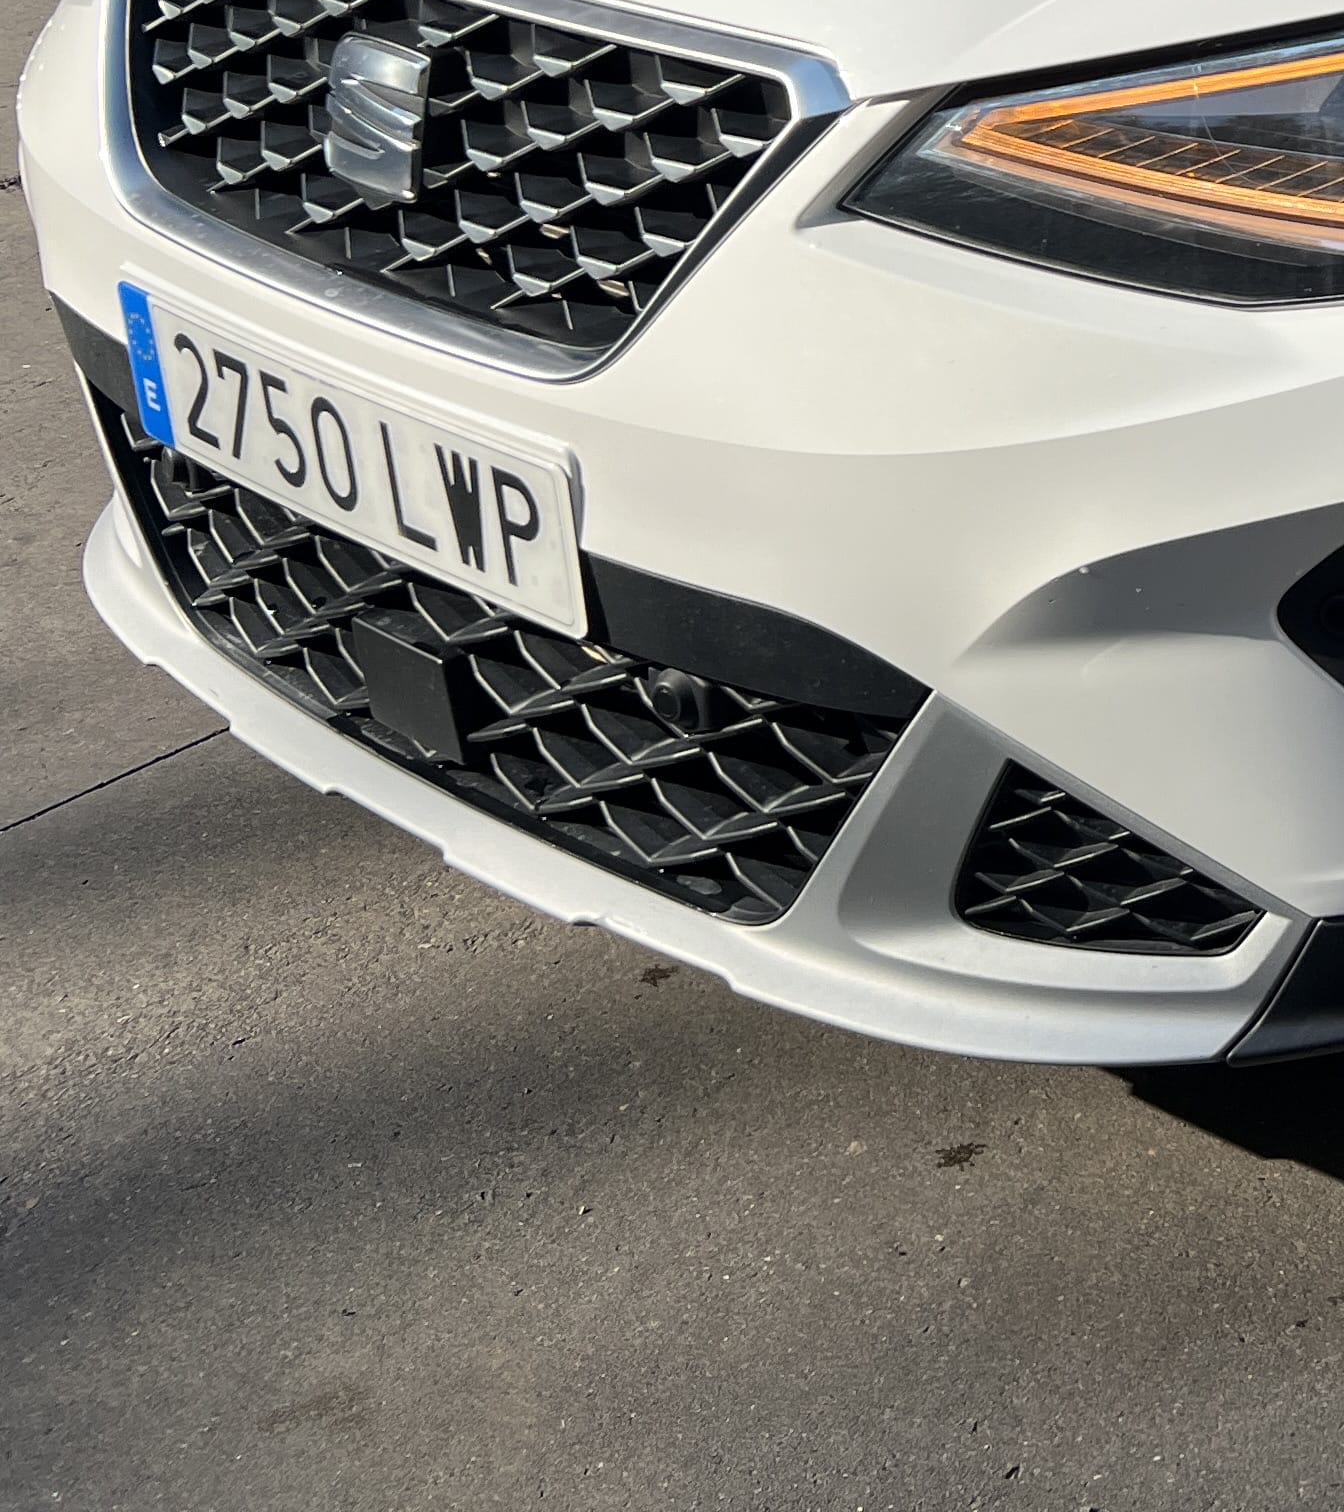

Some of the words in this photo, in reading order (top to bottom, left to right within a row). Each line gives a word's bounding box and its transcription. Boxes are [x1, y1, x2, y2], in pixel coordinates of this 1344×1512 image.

[143, 378, 161, 412] E
[173, 334, 359, 513] 2750
[378, 421, 541, 588] LWP
